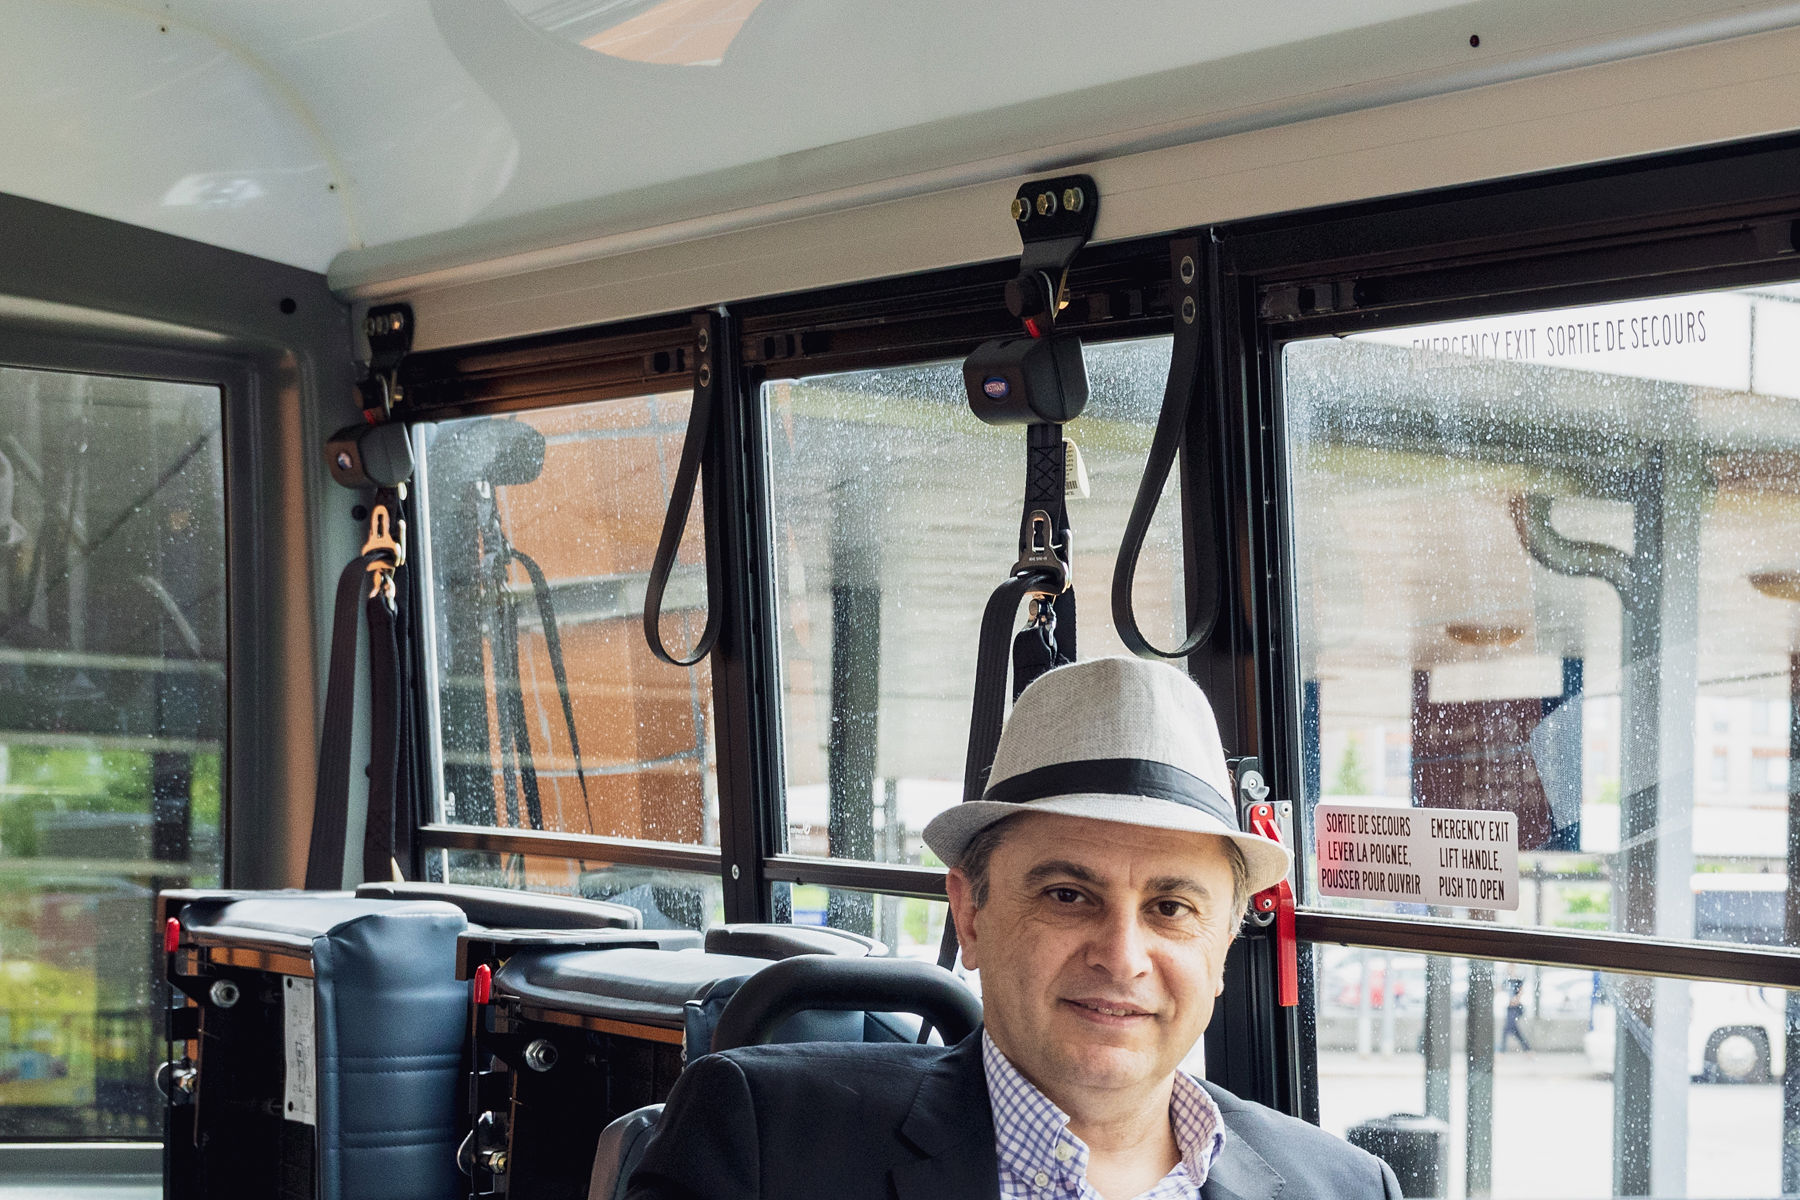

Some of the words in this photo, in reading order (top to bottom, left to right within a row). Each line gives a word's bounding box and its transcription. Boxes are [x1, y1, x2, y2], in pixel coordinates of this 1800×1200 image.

[1505, 327, 1537, 361] EXIT
[1546, 321, 1601, 357] SORTIE
[1606, 318, 1626, 351] DE
[1631, 310, 1707, 349] SECOURS
[1326, 812, 1356, 834] SORTIE
[1358, 814, 1370, 835] DE
[1371, 815, 1411, 837] SECOURS
[1431, 818, 1486, 841] EMERGENCY
[1489, 821, 1509, 842] EXIT
[1328, 840, 1355, 862] LEVER
[1356, 842, 1369, 863] LA
[1369, 843, 1412, 867] POIGNEE,
[1439, 847, 1459, 868] LIFT
[1321, 868, 1360, 890] POUSSER
[1362, 870, 1386, 892] POUR
[1387, 872, 1421, 895] OUVRIR
[1439, 876, 1464, 898] PUSH
[1465, 878, 1478, 899] TO
[1480, 879, 1505, 901] OPEN
